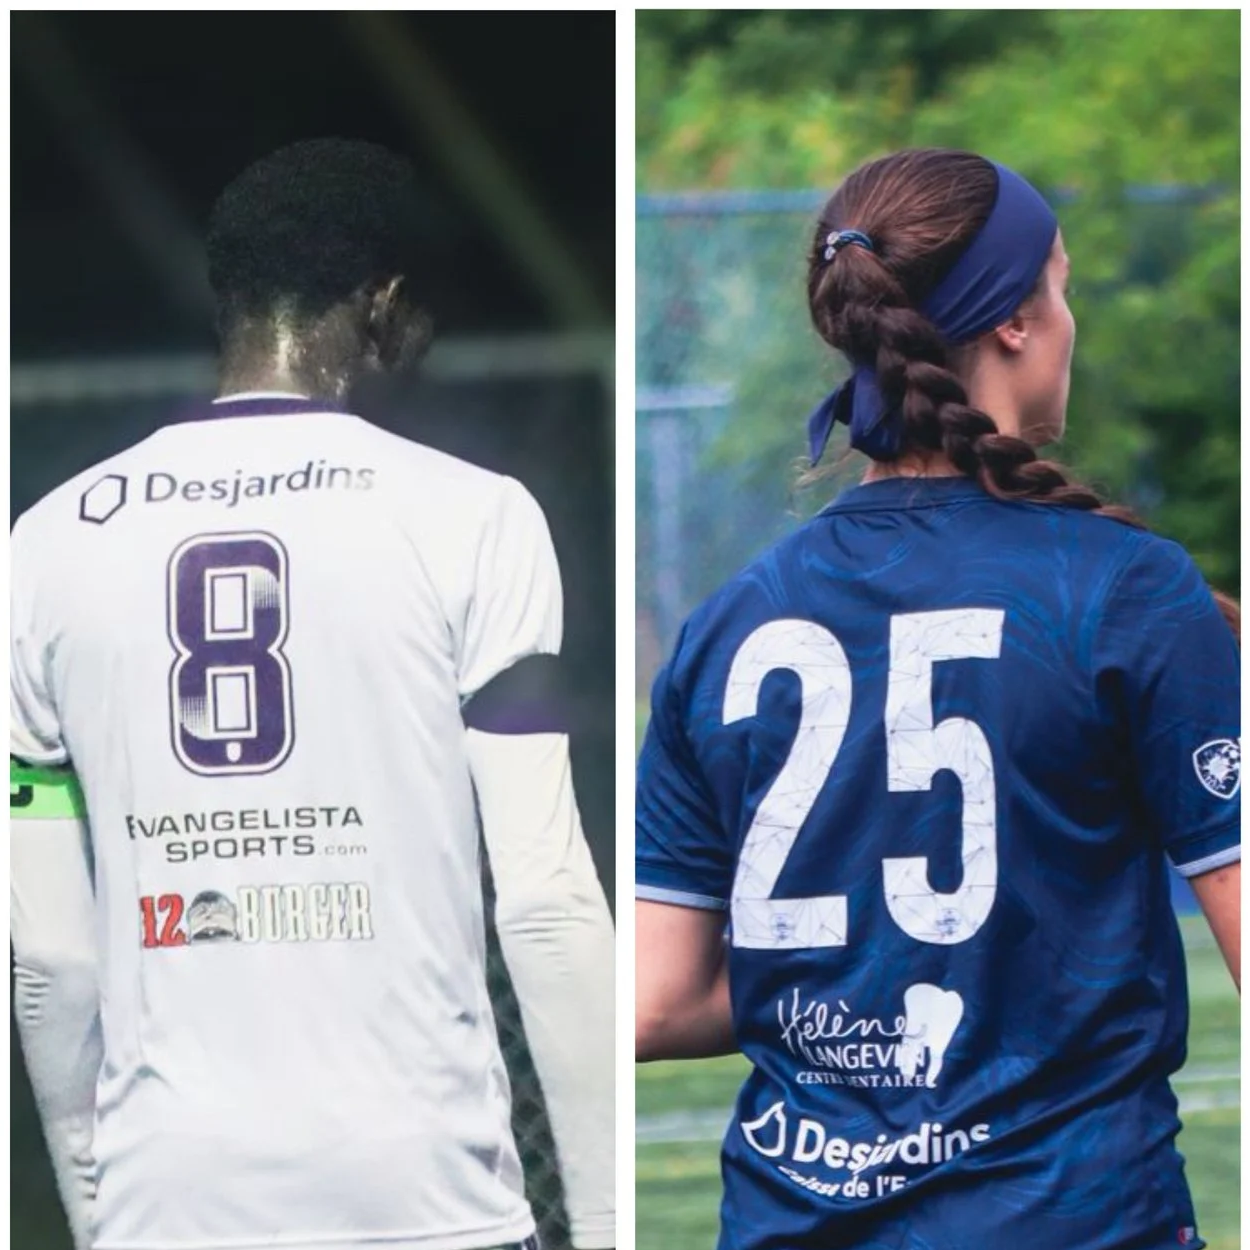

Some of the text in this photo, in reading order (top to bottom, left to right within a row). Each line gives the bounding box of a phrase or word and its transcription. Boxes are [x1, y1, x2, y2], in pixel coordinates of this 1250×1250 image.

[144, 459, 376, 508] Desjardins
[166, 530, 296, 777] 8
[721, 608, 1006, 950] 25
[125, 806, 365, 840] EVANGELISTA
[236, 881, 376, 943] BURGER
[777, 987, 928, 1056] Hélène
[842, 1175, 870, 1198] de
